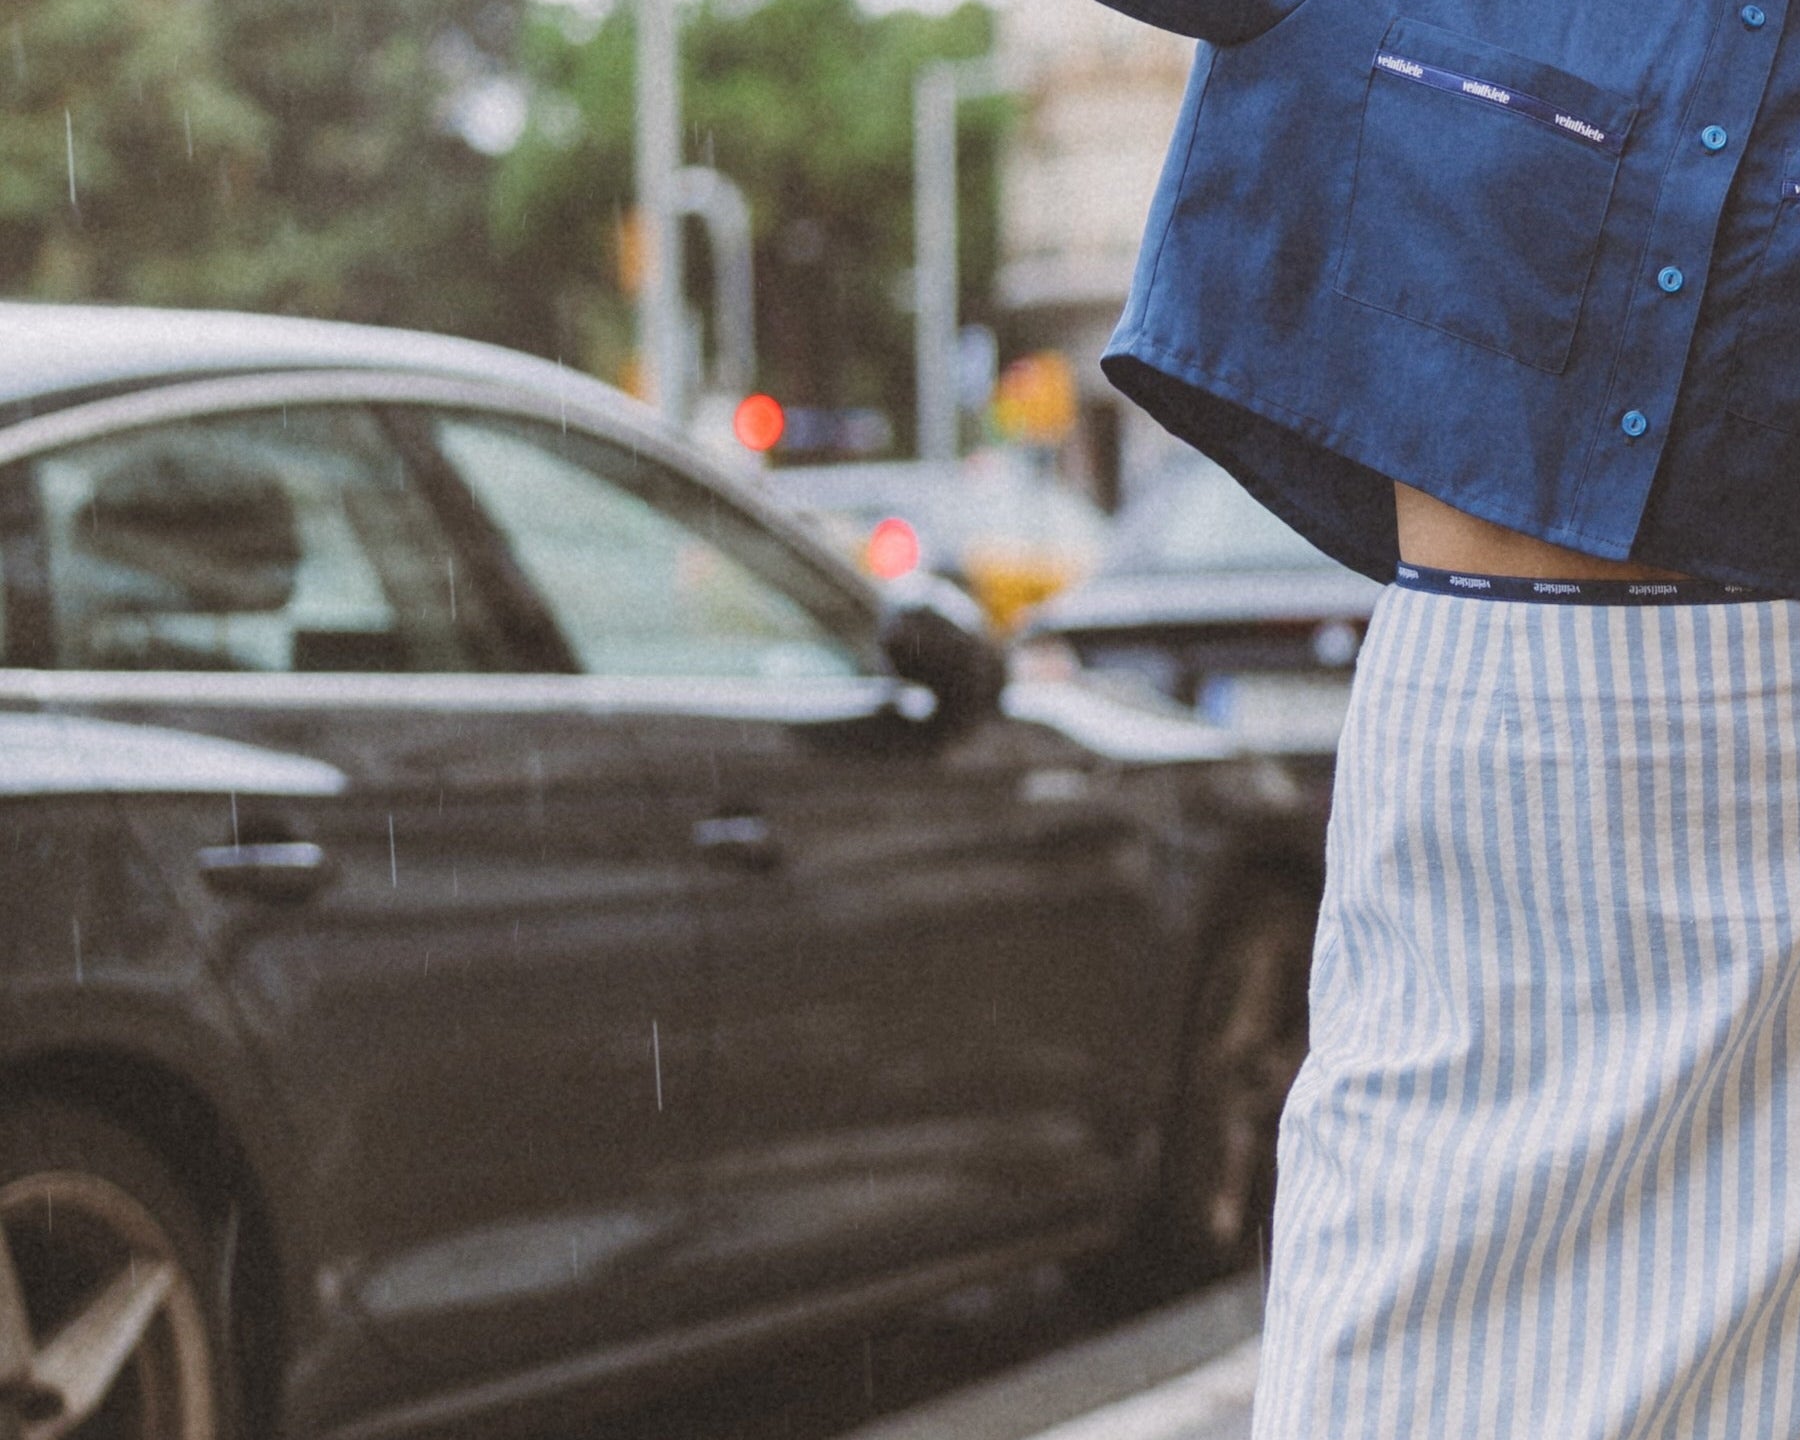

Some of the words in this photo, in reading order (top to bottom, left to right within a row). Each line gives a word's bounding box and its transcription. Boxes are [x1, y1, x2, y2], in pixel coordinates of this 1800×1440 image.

[1378, 55, 1423, 78] veintisiete
[1462, 81, 1510, 104] veintisiete
[1555, 113, 1605, 143] veintisiete
[1533, 582, 1581, 594] veintisiete
[1629, 583, 1678, 595] veintisiete
